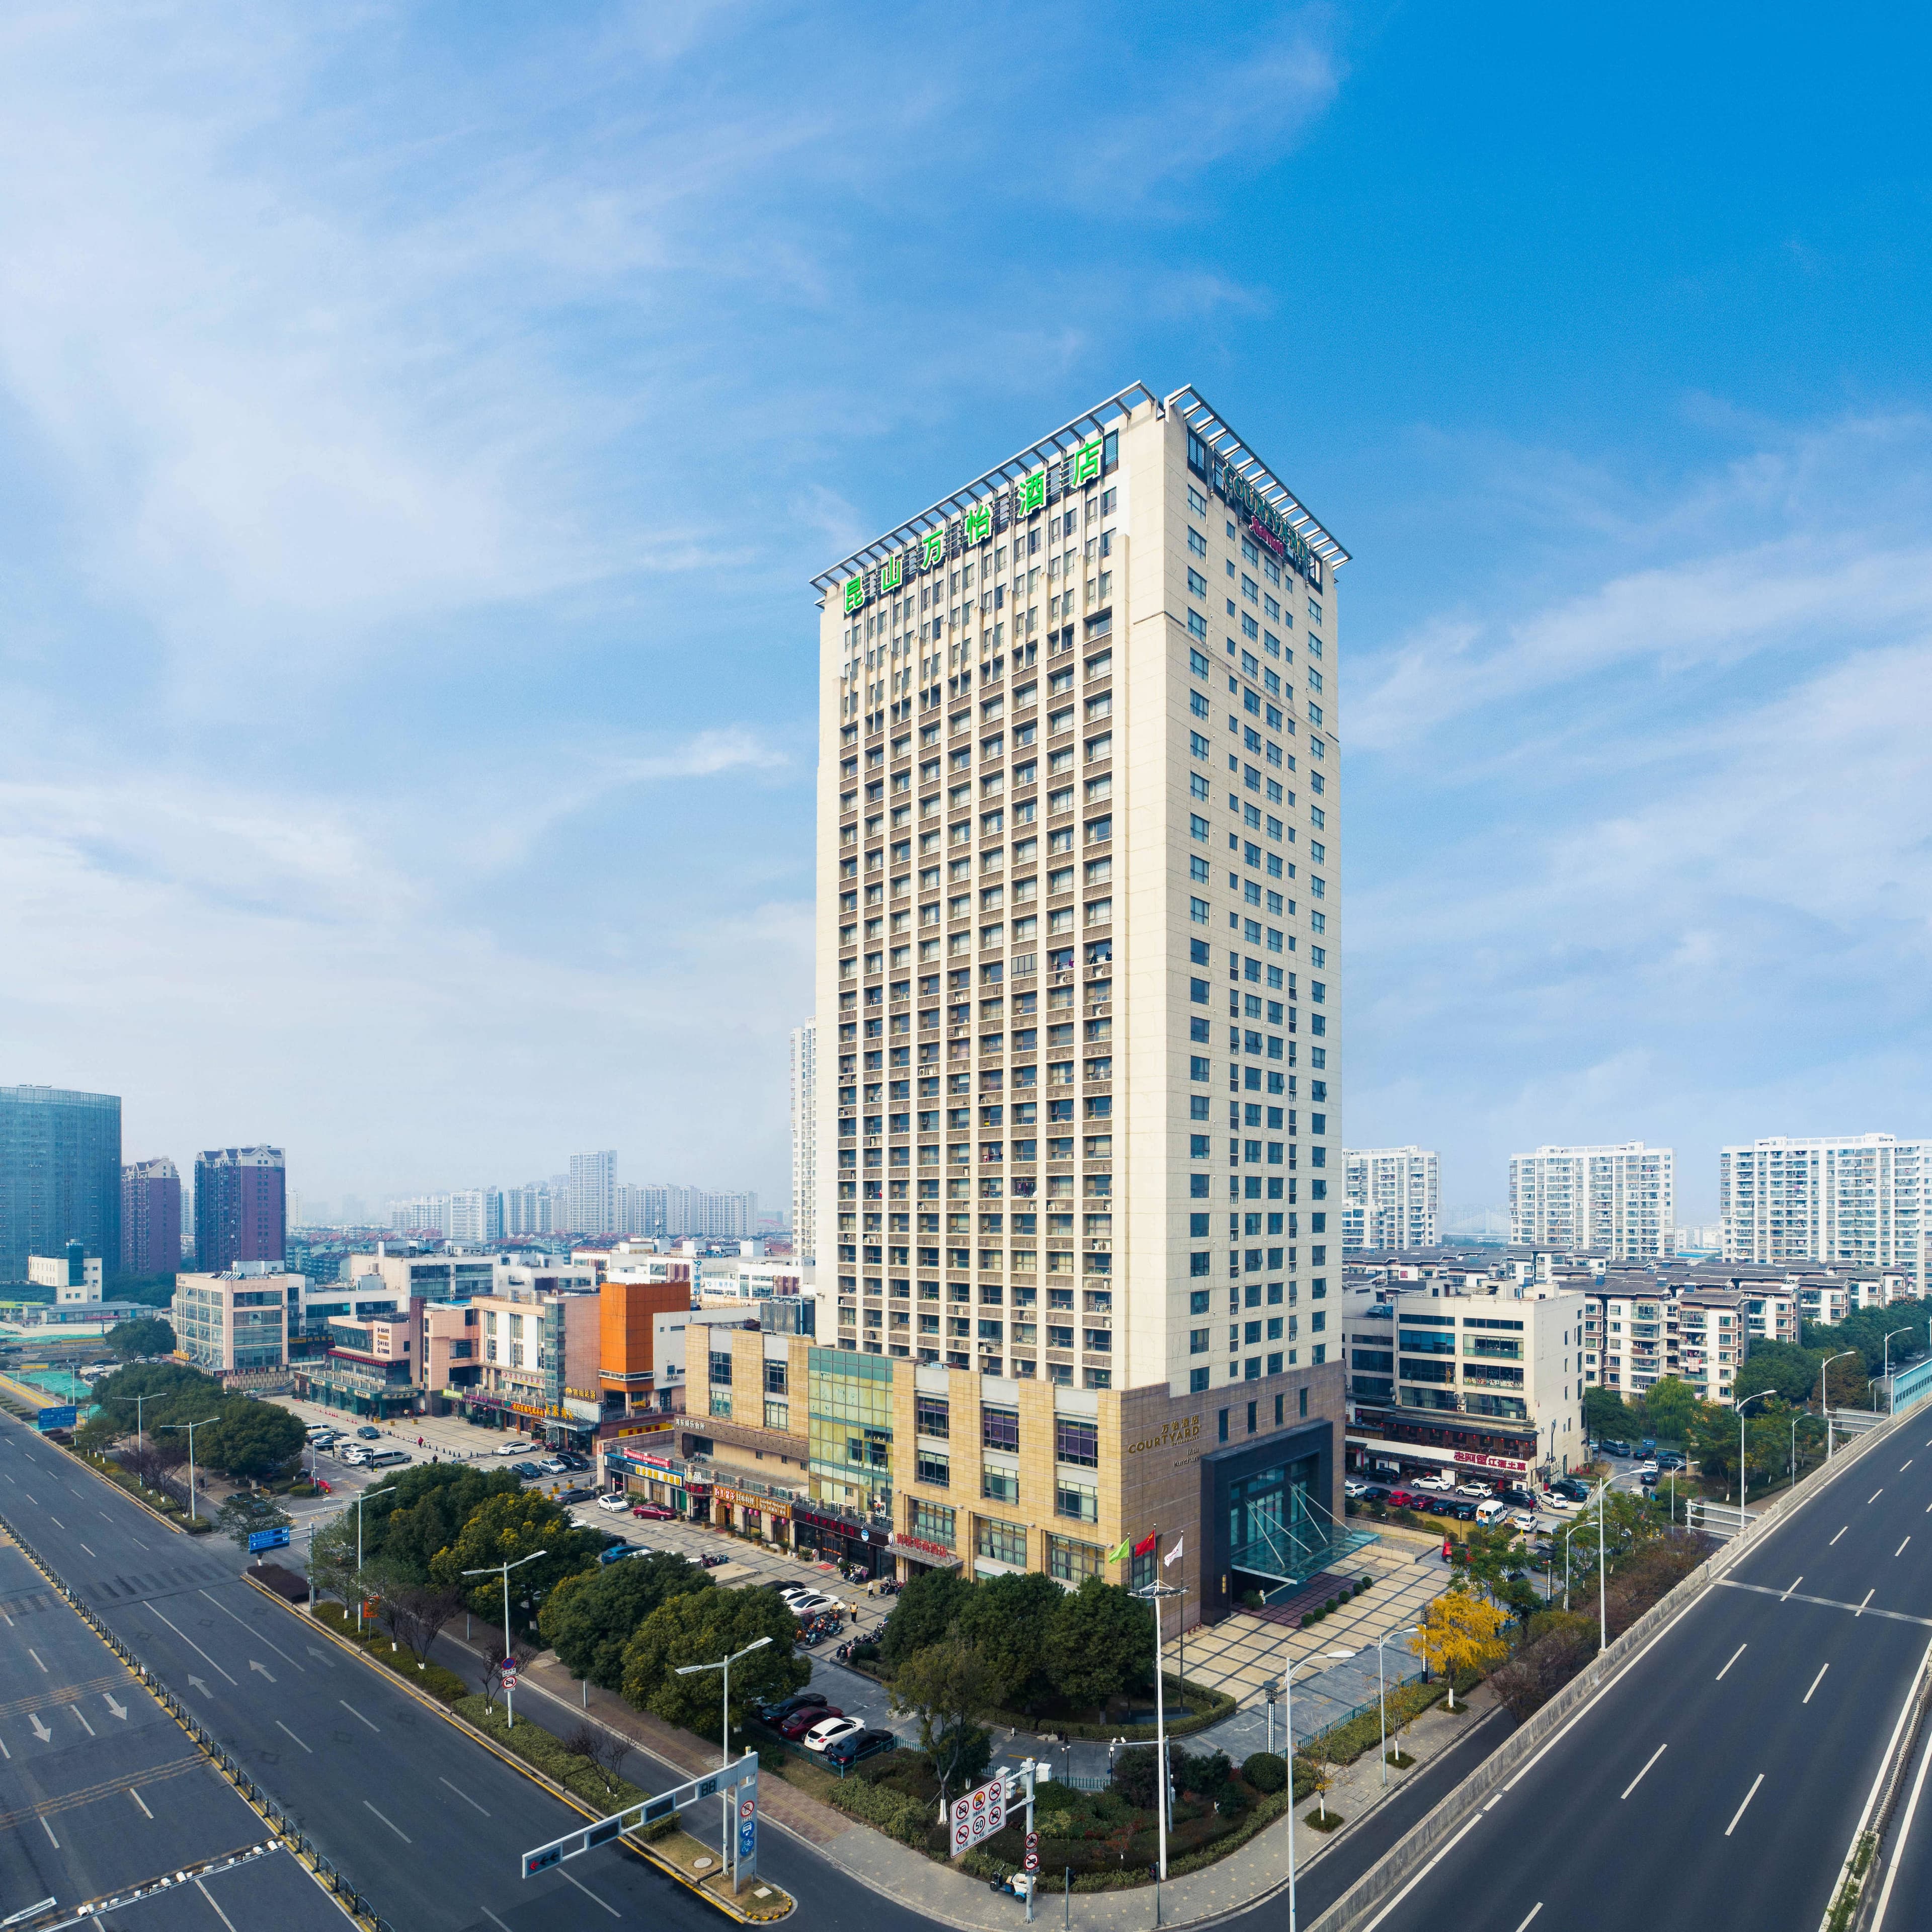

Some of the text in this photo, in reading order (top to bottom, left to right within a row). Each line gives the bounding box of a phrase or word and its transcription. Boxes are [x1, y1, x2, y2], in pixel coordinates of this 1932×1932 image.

[844, 437, 1103, 614] 昆山万怡酒店
[1161, 1415, 1199, 1433] 万怡酒店
[1128, 1426, 1199, 1454] COURTYARD
[736, 1494, 755, 1505] 日本料理
[975, 1819, 984, 1831] 50
